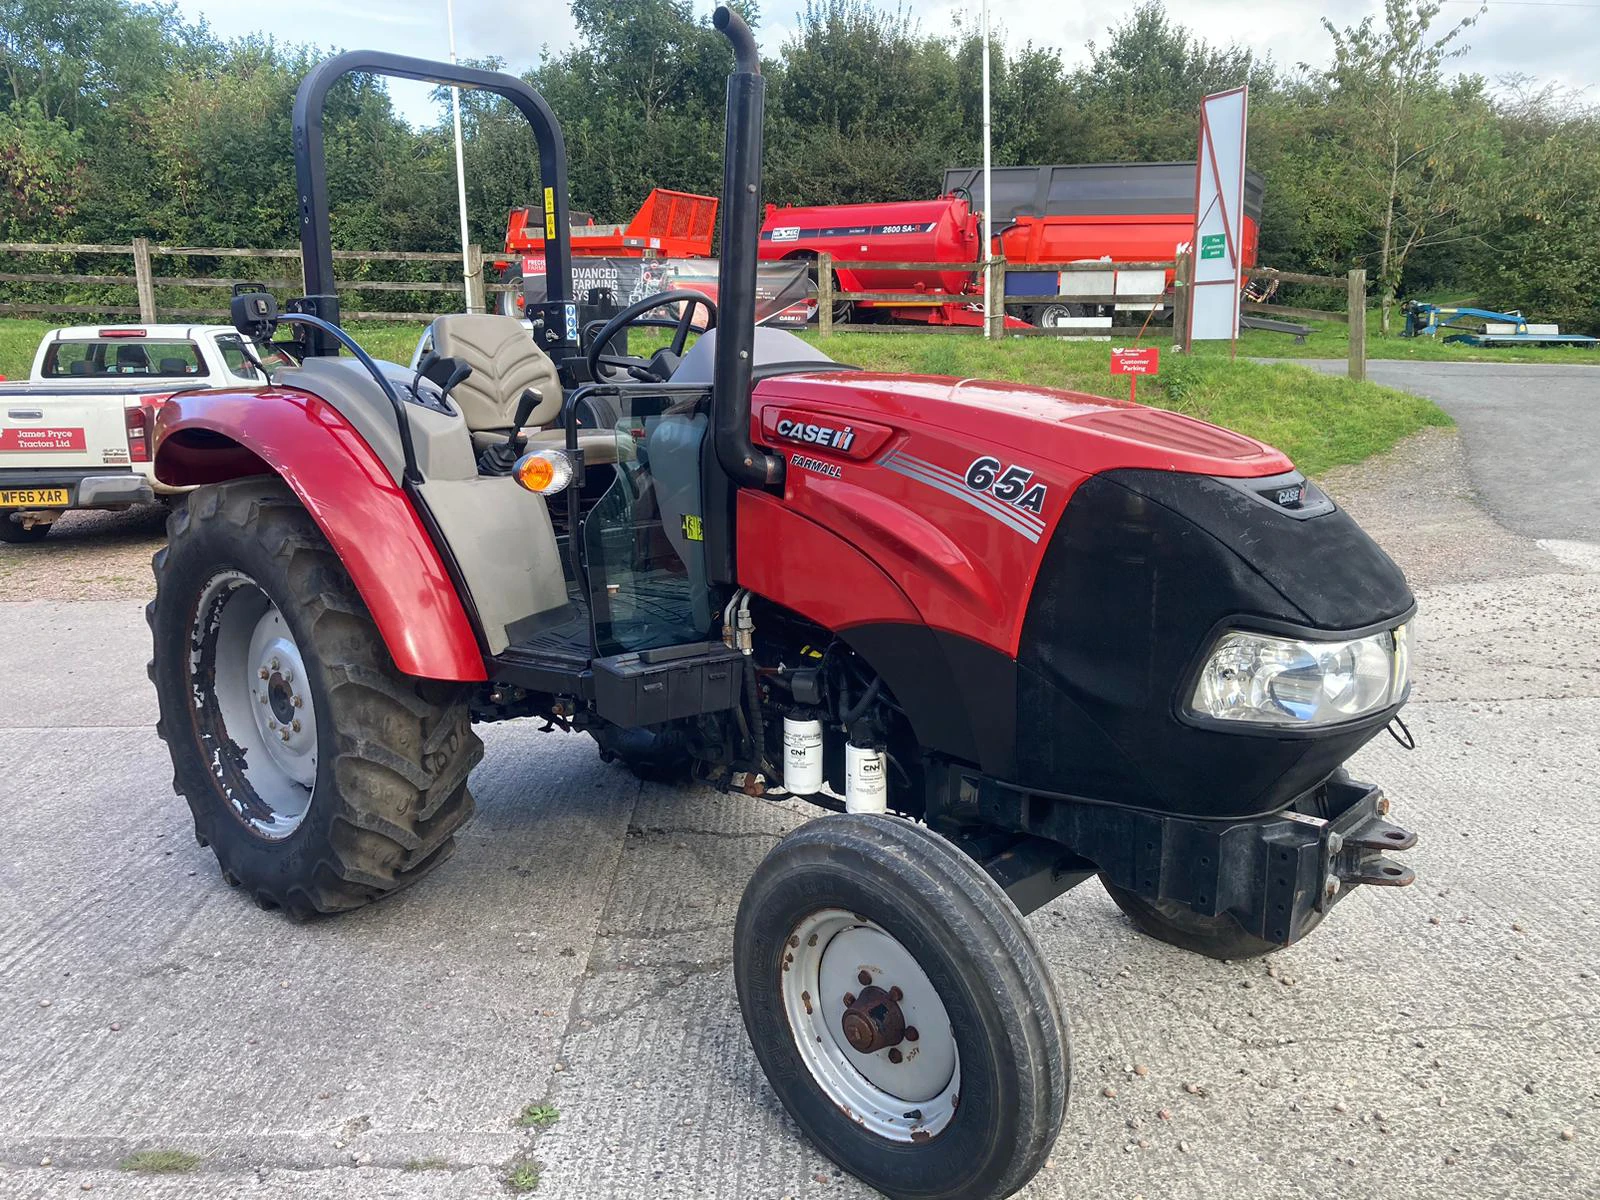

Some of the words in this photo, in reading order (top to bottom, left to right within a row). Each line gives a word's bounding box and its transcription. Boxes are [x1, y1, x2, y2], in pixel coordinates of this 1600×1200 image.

[882, 225, 901, 233] 2600
[571, 267, 618, 279] DVANCED
[573, 279, 618, 291] FARMING
[572, 290, 618, 301] SYSS
[47, 430, 73, 439] Pryce
[777, 419, 832, 446] CASE
[18, 440, 55, 448] Tractors
[56, 440, 71, 448] Ltd
[790, 453, 842, 479] FARMALL
[965, 456, 1048, 514] 65A
[2, 491, 35, 503] WF66
[38, 490, 62, 502] XAR
[1279, 490, 1299, 504] CASE
[790, 748, 806, 756] CNH
[863, 762, 880, 771] CNH
